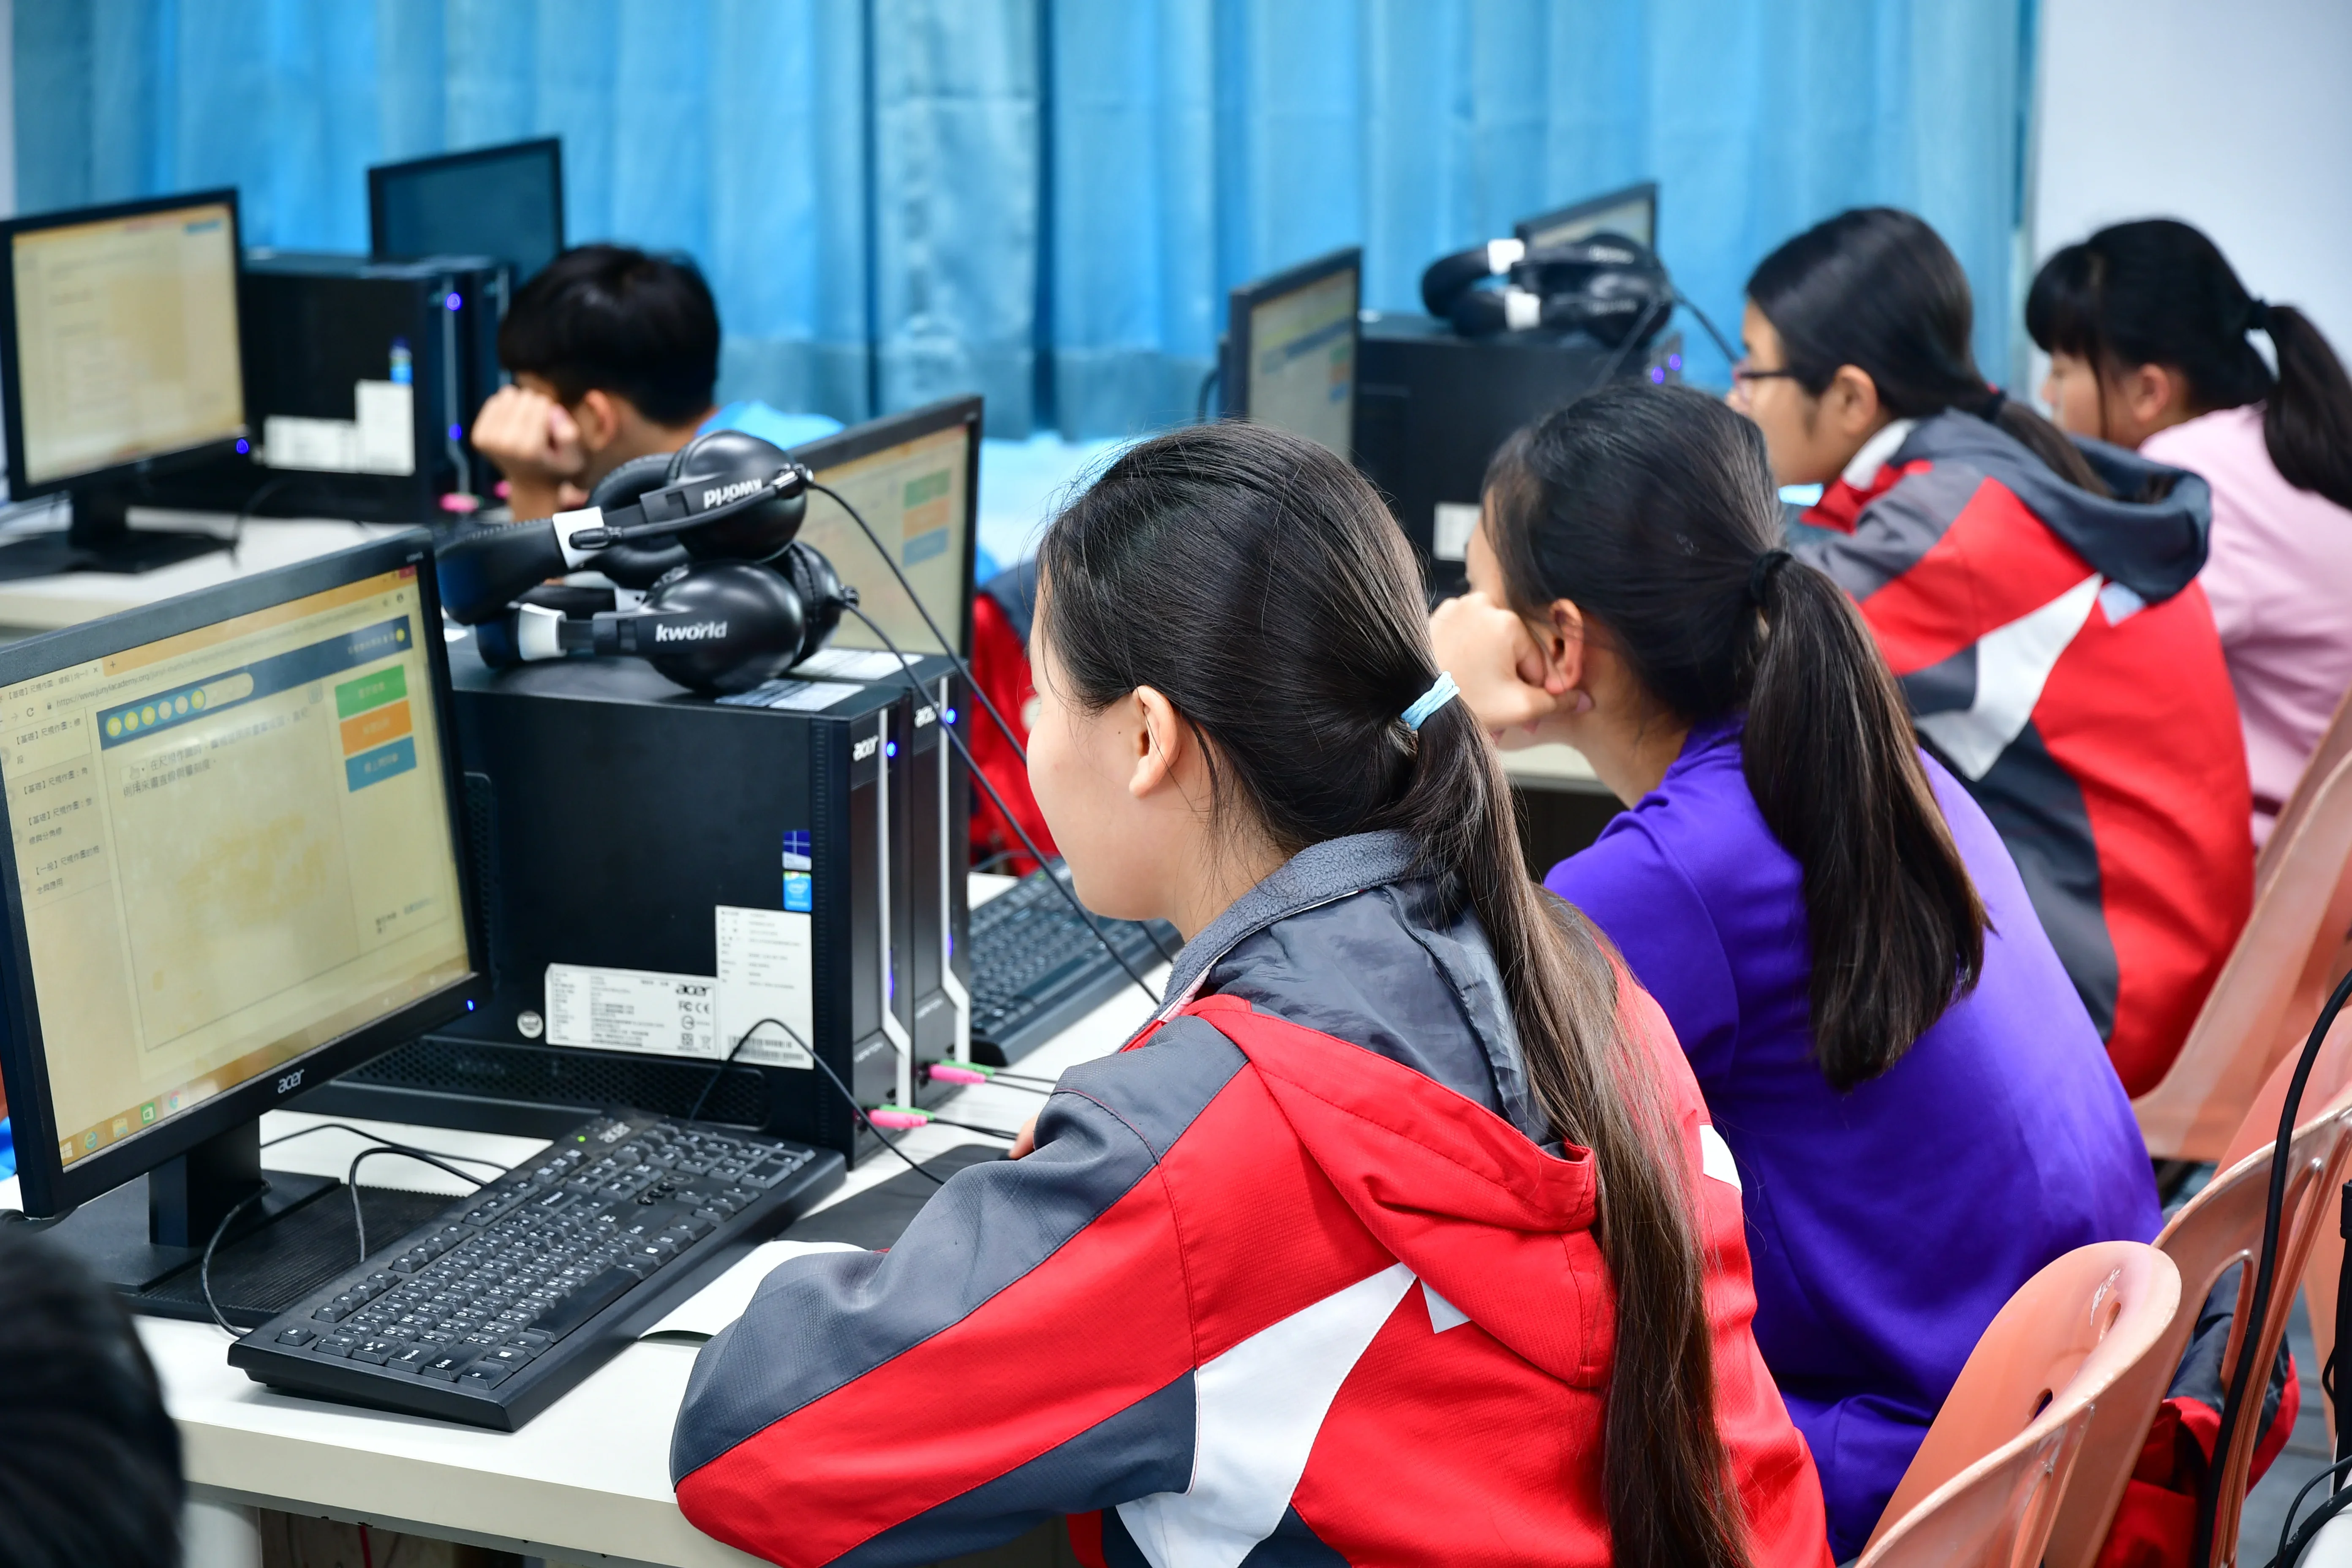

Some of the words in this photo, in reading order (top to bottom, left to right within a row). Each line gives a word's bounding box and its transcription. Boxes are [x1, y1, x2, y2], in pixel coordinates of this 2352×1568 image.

[656, 621, 727, 642] kworld
[914, 705, 937, 728] ace
[853, 735, 879, 762] acer
[675, 984, 711, 996] acer
[278, 1069, 305, 1094] acer
